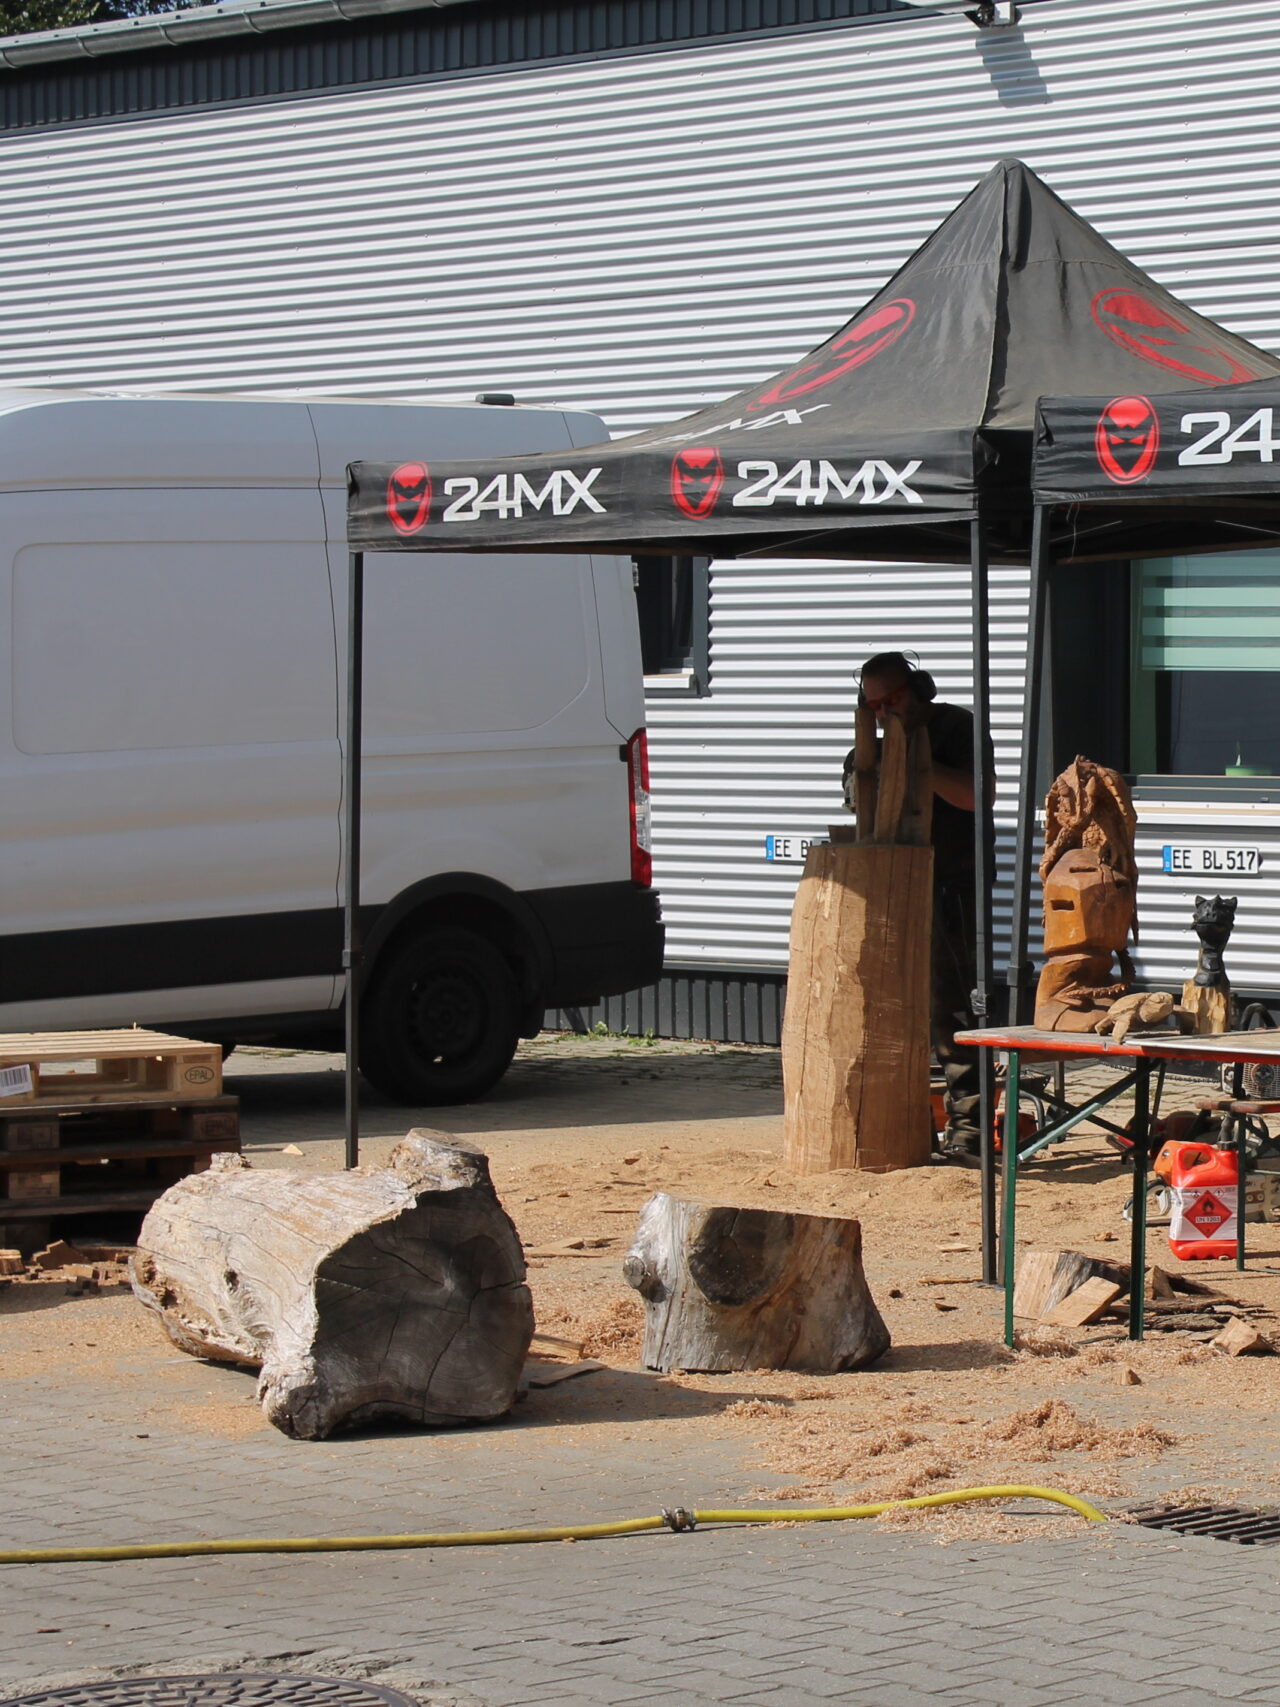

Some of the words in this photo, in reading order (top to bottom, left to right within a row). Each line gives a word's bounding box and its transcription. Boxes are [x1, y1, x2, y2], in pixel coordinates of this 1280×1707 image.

[442, 467, 607, 522] 24MX
[732, 459, 924, 507] 24MX
[775, 839, 791, 858] EE
[1173, 850, 1192, 869] EE
